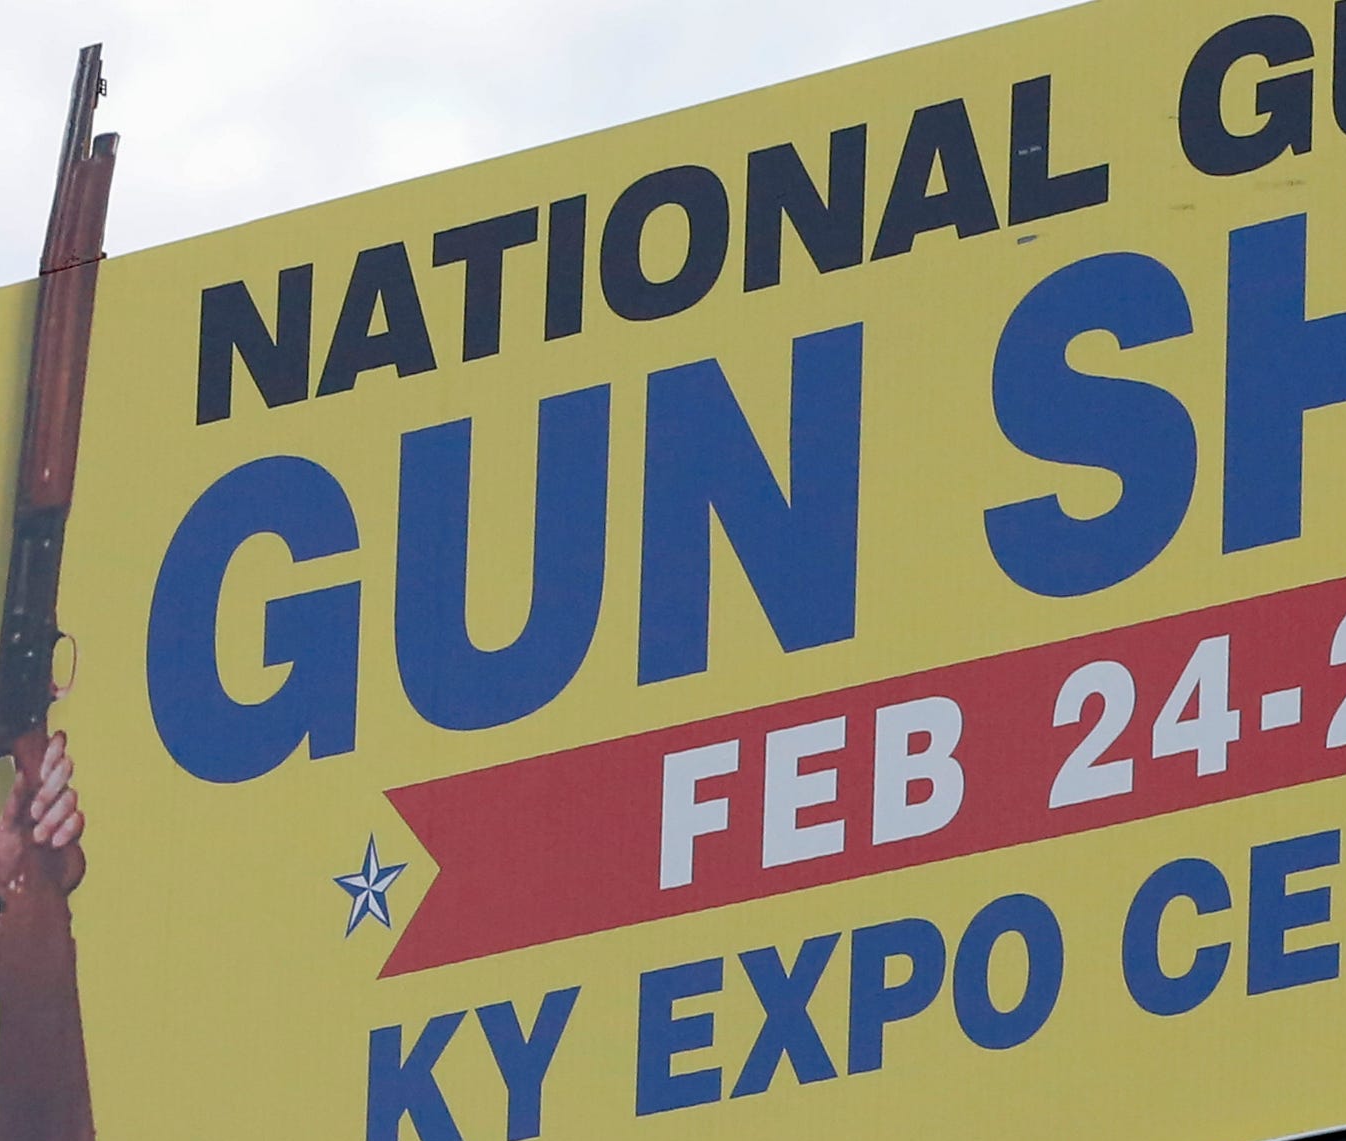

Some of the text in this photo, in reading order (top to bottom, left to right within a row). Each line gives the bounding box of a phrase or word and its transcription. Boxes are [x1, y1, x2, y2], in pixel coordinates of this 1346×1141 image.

[196, 74, 1109, 426] NATIONAL
[146, 320, 863, 784] GUN
[658, 695, 966, 891] FEB
[634, 892, 1065, 1117] EXPO
